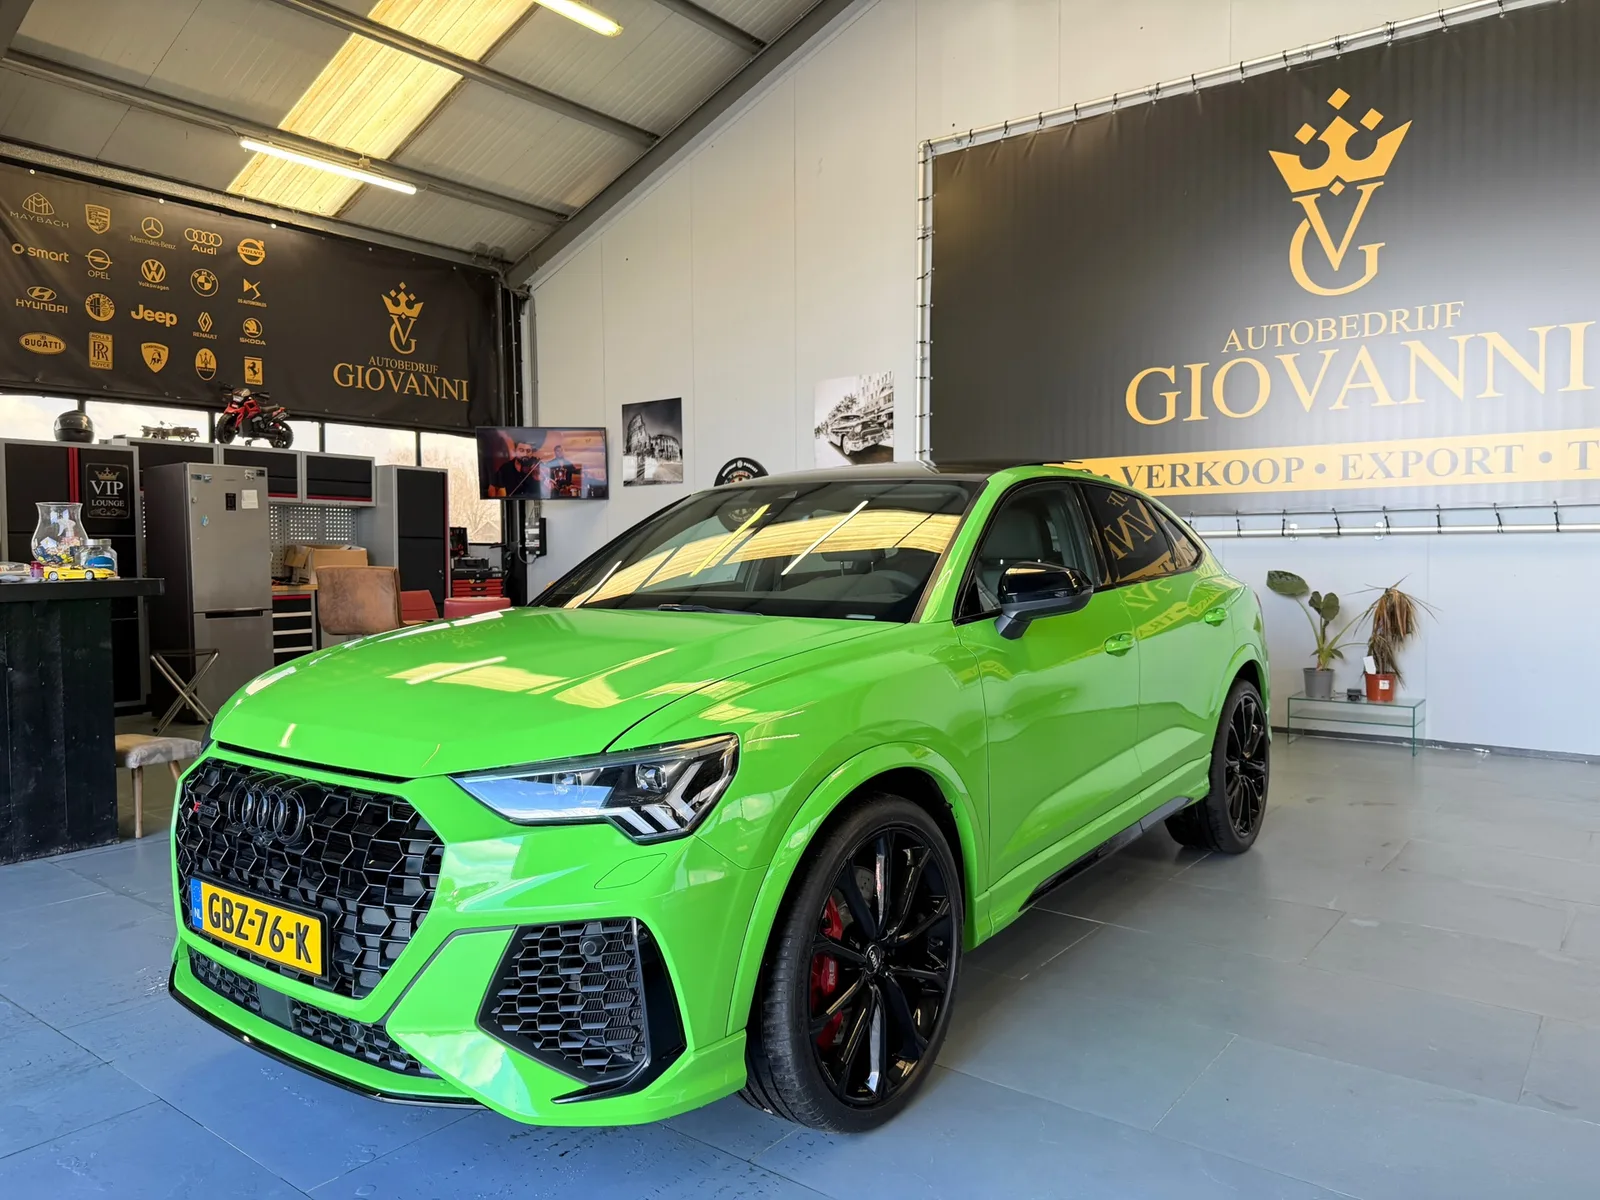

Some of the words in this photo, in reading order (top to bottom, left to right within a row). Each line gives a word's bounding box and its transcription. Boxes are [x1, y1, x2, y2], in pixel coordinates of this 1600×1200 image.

[9, 211, 70, 229] MAYBACH
[129, 234, 177, 251] Mercedes-Benz
[191, 243, 217, 256] Audi
[27, 246, 70, 263] smart
[240, 247, 264, 256] VOLVO
[87, 269, 111, 281] OPEL
[138, 280, 170, 292] Volkswagen
[15, 298, 69, 314] HYUNDAI
[130, 304, 178, 328] Jeep
[1221, 300, 1465, 353] AUTOBEDRIJF
[192, 331, 218, 340] RENAULT
[24, 338, 62, 350] BUGATTI
[368, 355, 439, 375] AUTOBEDRIJF
[1125, 321, 1597, 426] GIOVANNI
[332, 362, 469, 402] GIOVANNI
[1120, 457, 1305, 489] VERKOOP
[1340, 444, 1525, 482] EXPORT
[90, 480, 124, 496] VIP
[91, 499, 125, 507] LOUNGE
[193, 908, 203, 920] NL
[207, 892, 313, 964] GBZ-76-K
